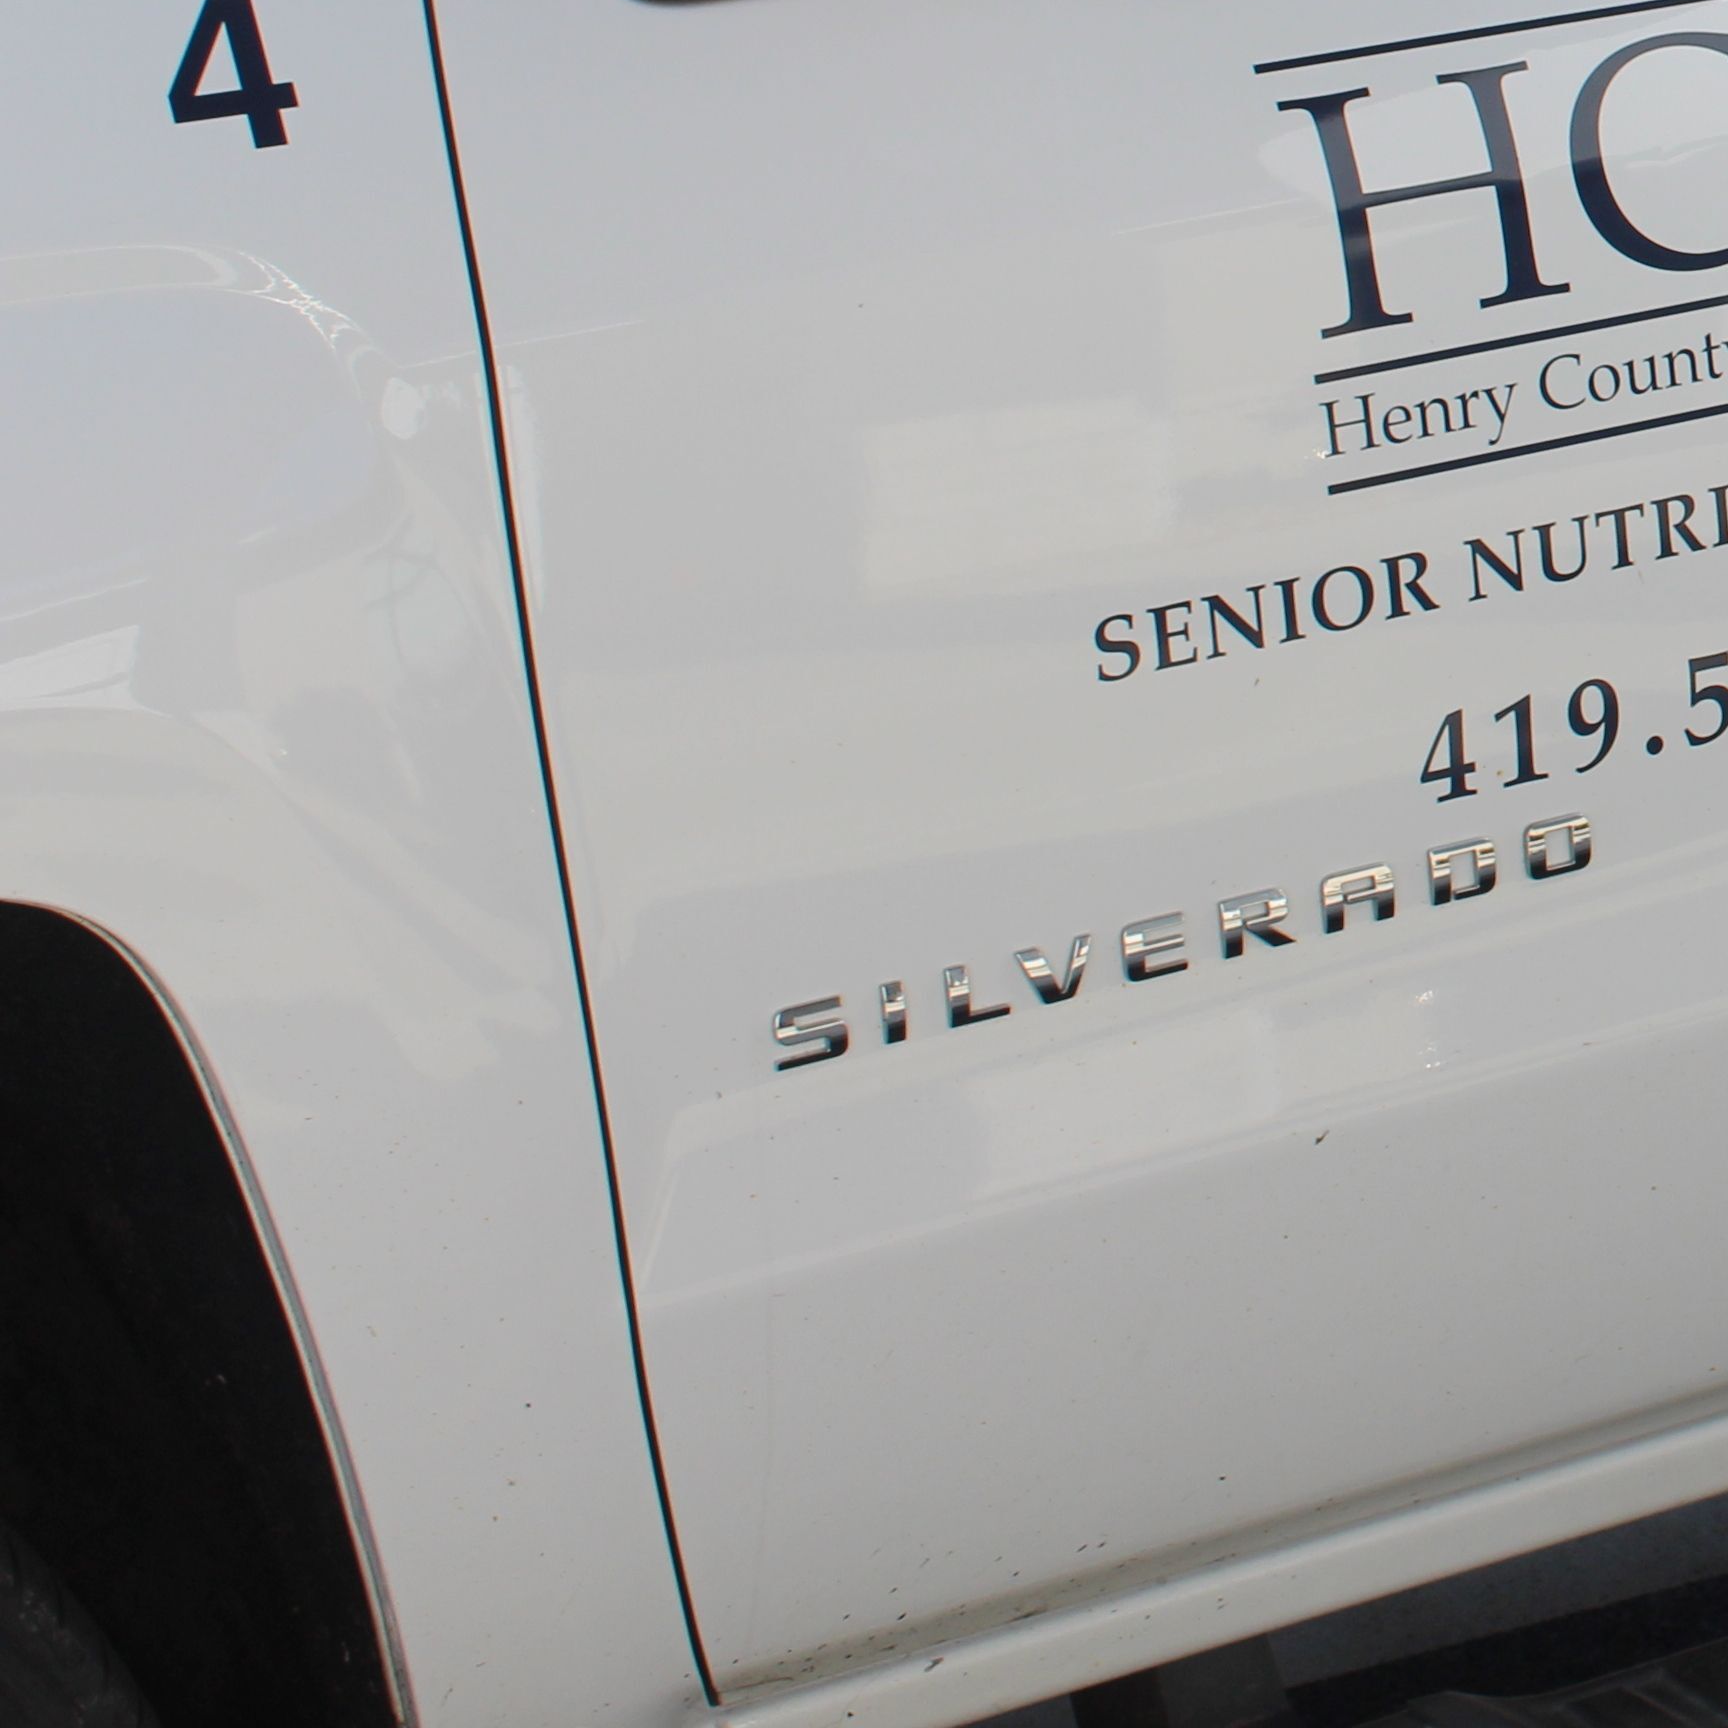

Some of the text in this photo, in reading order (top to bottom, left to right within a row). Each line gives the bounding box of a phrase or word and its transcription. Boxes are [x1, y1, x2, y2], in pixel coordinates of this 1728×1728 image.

[1319, 382, 1518, 458] Henry
[1094, 552, 1440, 682] SENIOR
[772, 812, 1593, 1072] SILVERADO
